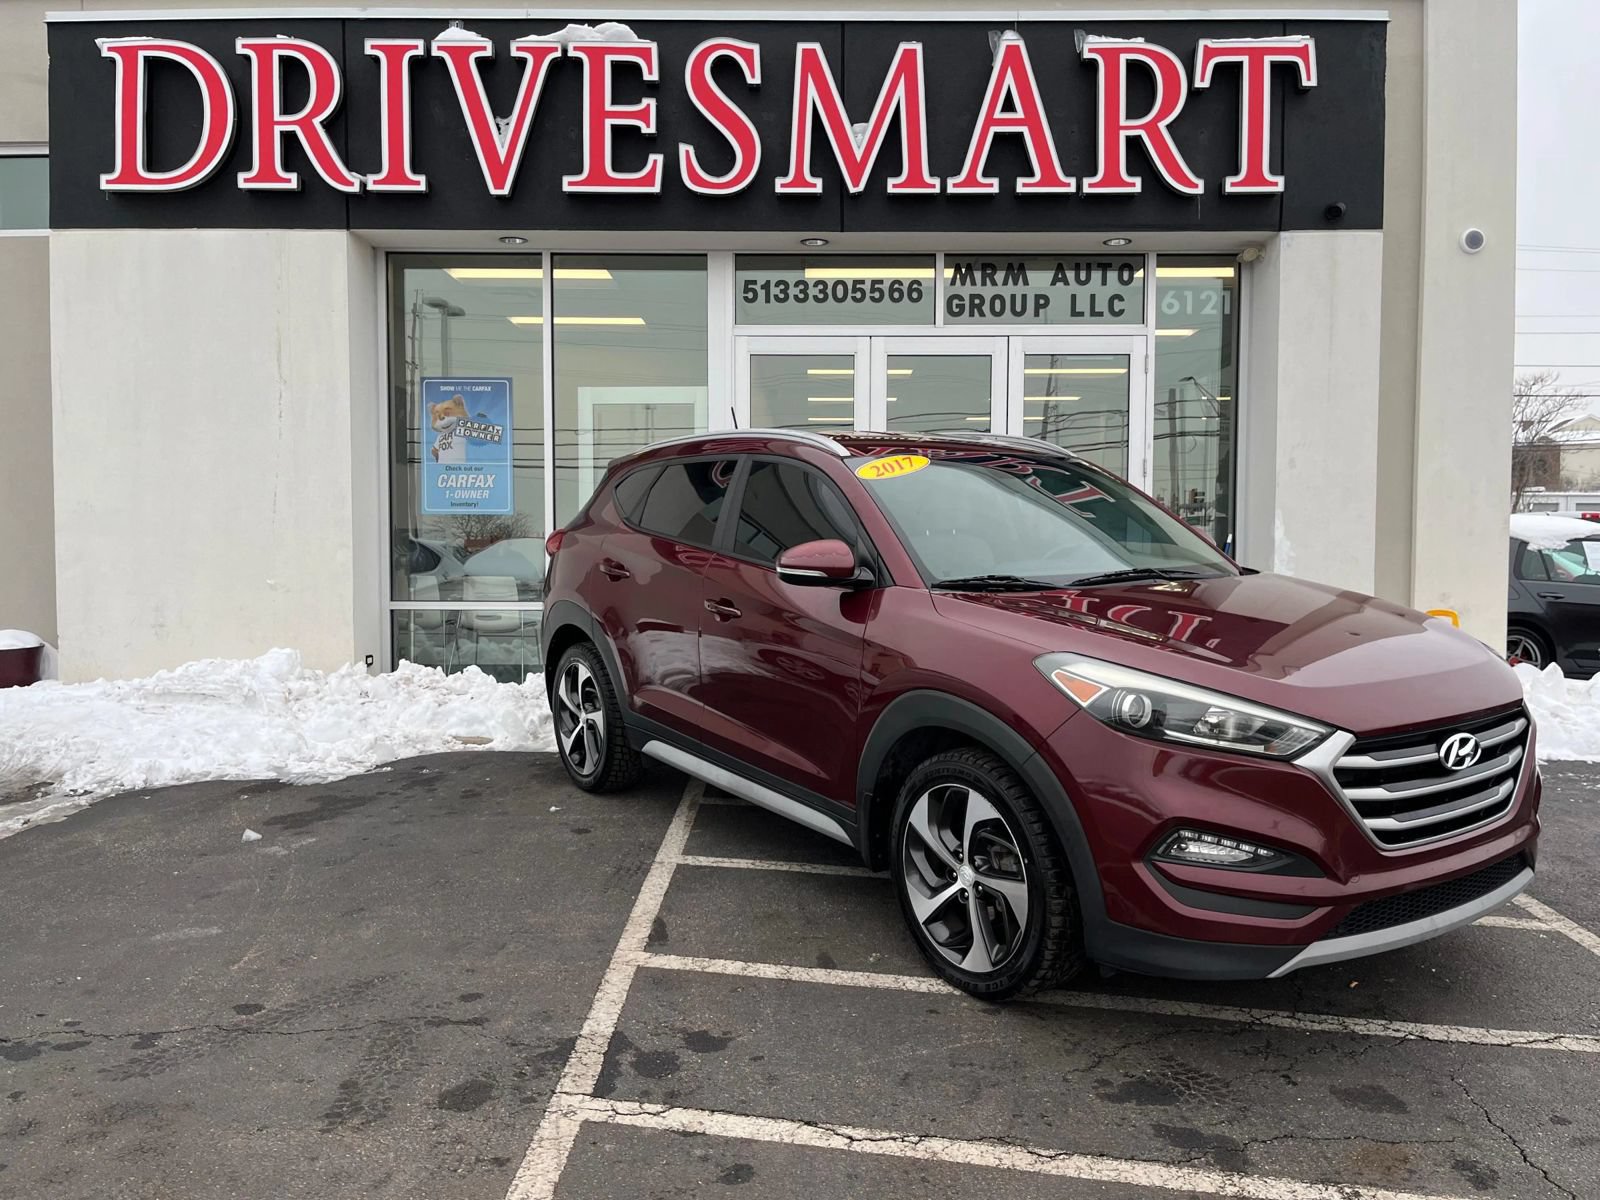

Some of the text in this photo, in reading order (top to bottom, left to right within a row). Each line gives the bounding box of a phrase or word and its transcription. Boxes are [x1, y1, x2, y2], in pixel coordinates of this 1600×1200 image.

[97, 34, 1318, 197] DRIVESMART
[949, 262, 1136, 287] MRM AUTO
[742, 279, 924, 304] 5133305566
[1161, 289, 1232, 316] 6121
[946, 292, 1126, 318] GROUP LLC
[459, 420, 502, 435] CARFAX
[464, 430, 500, 442] OWNER
[870, 456, 914, 477] 2017
[437, 474, 496, 488] CARFAX
[445, 489, 489, 499] 1-OWNER
